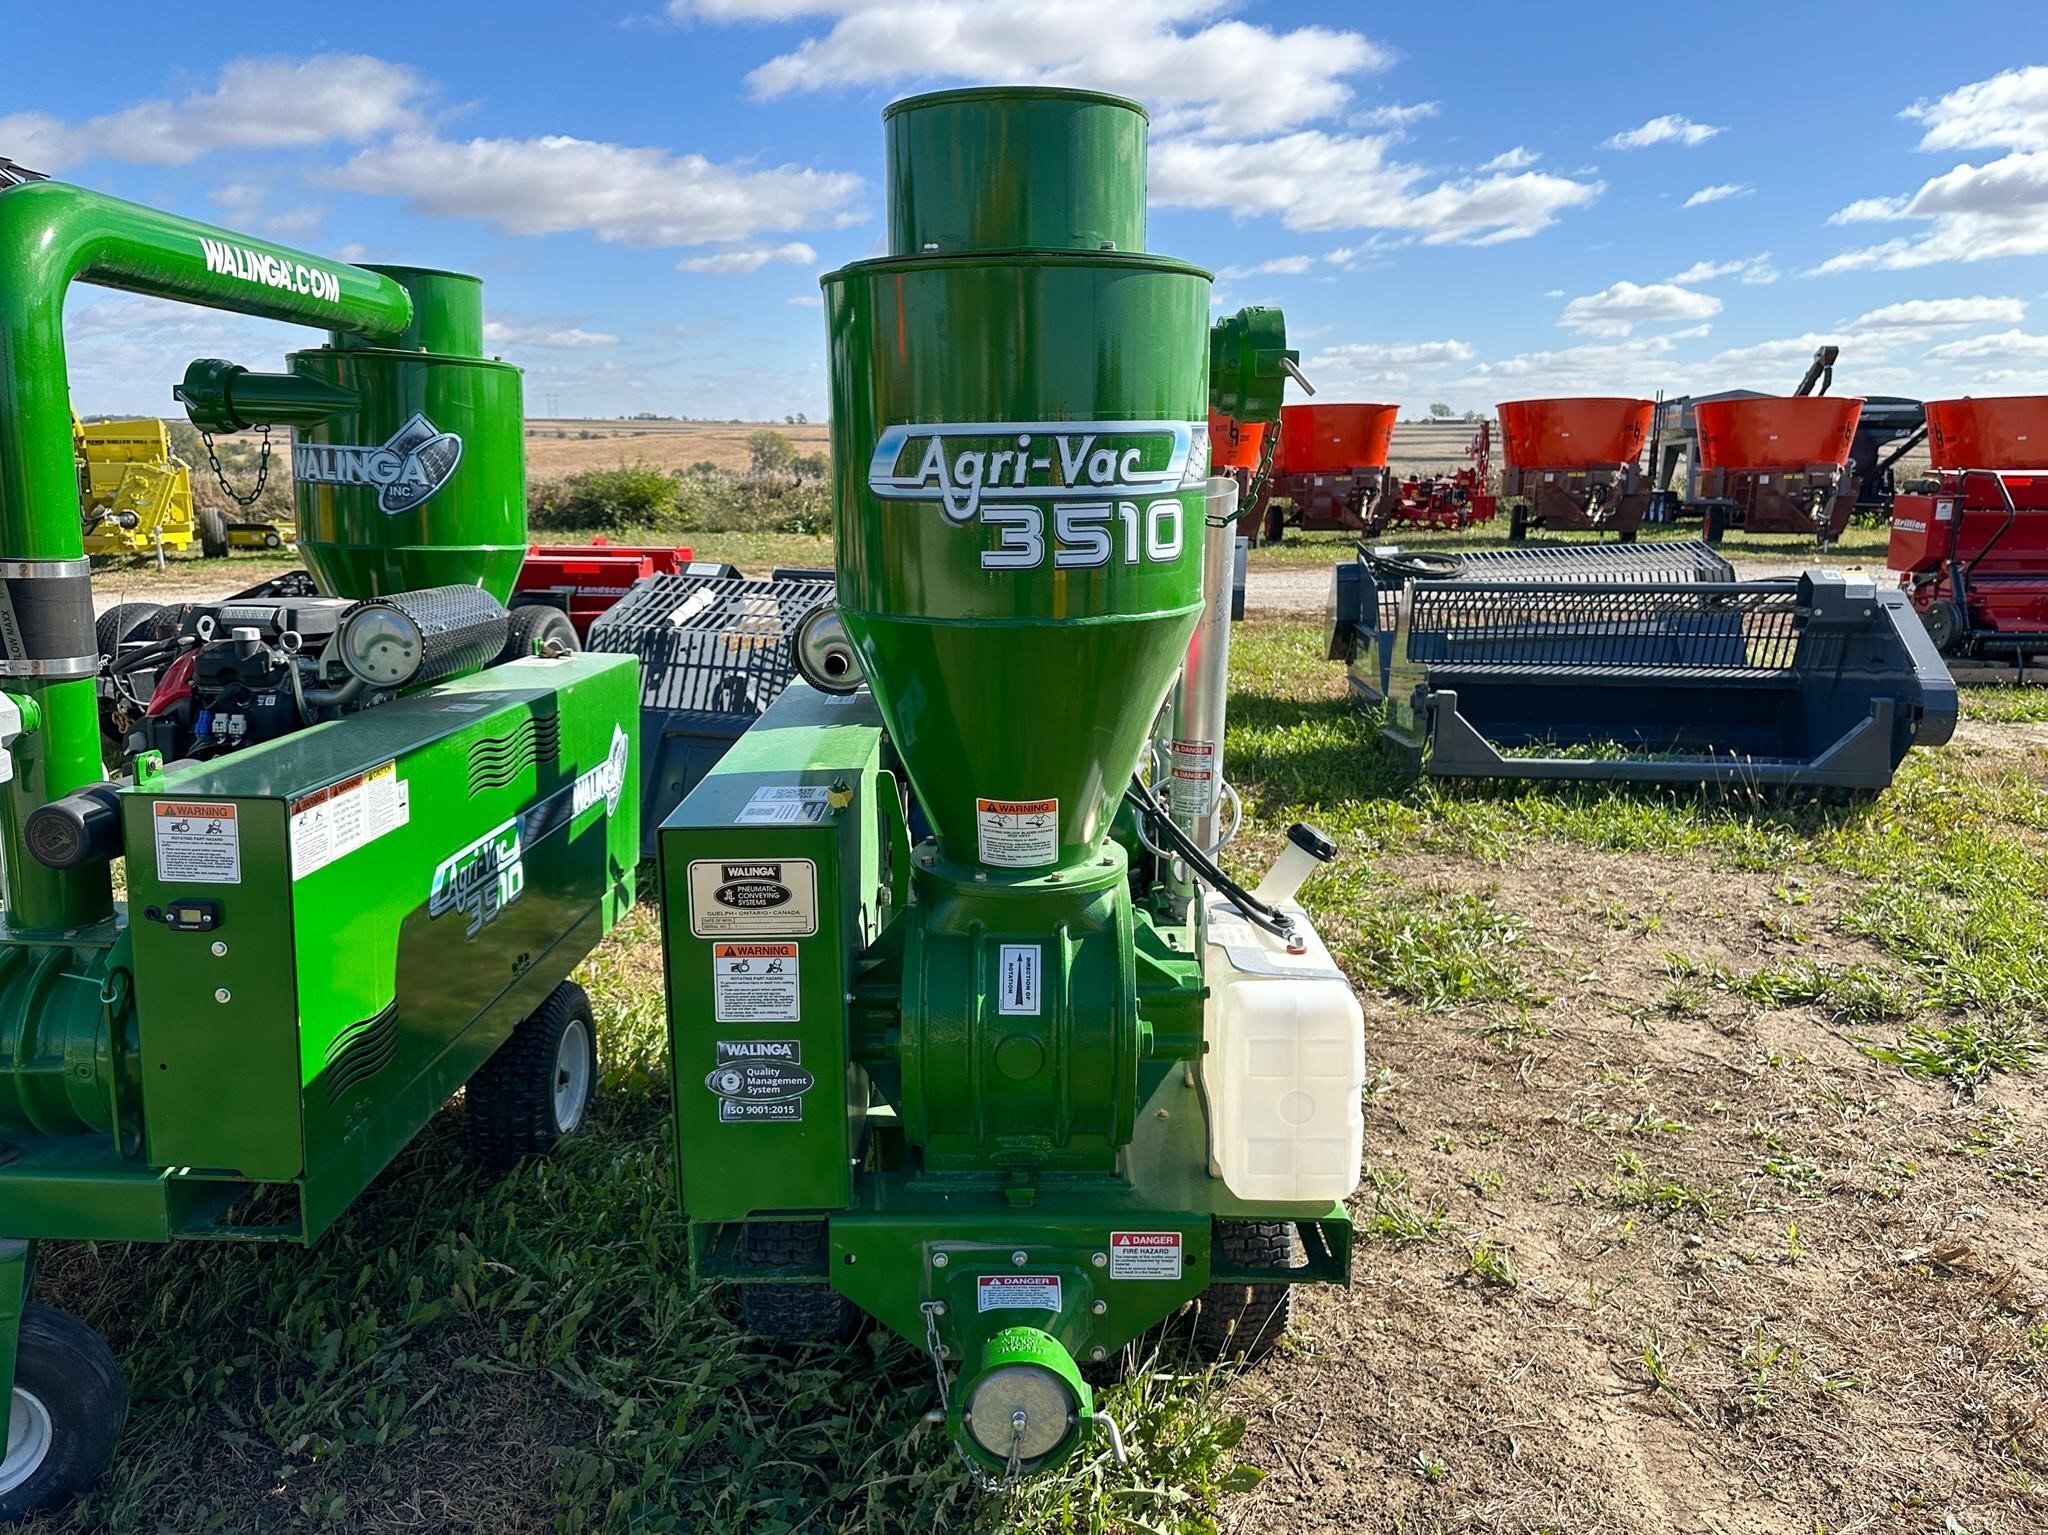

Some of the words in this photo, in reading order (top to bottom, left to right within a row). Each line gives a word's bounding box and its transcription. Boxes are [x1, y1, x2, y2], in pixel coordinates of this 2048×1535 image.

[294, 448, 430, 485] WALINGA
[900, 434, 1163, 520] Agri-Vac
[389, 486, 414, 497] INC.
[980, 499, 1182, 569] 3510
[176, 805, 228, 817] WARNING
[998, 803, 1049, 813] WARNING
[446, 839, 514, 914] Agri-Vac
[728, 867, 776, 877] WALINGA
[466, 861, 523, 940] 3510
[737, 946, 789, 955] WARNING
[1025, 991, 1031, 1001] OF
[726, 1043, 792, 1056] WALINGA
[746, 1068, 780, 1077] Quality
[747, 1077, 807, 1086] Management
[747, 1086, 780, 1095] System
[727, 1105, 744, 1114] ISO
[746, 1105, 795, 1114] 9001:2015
[1132, 1236, 1174, 1245] DANGER
